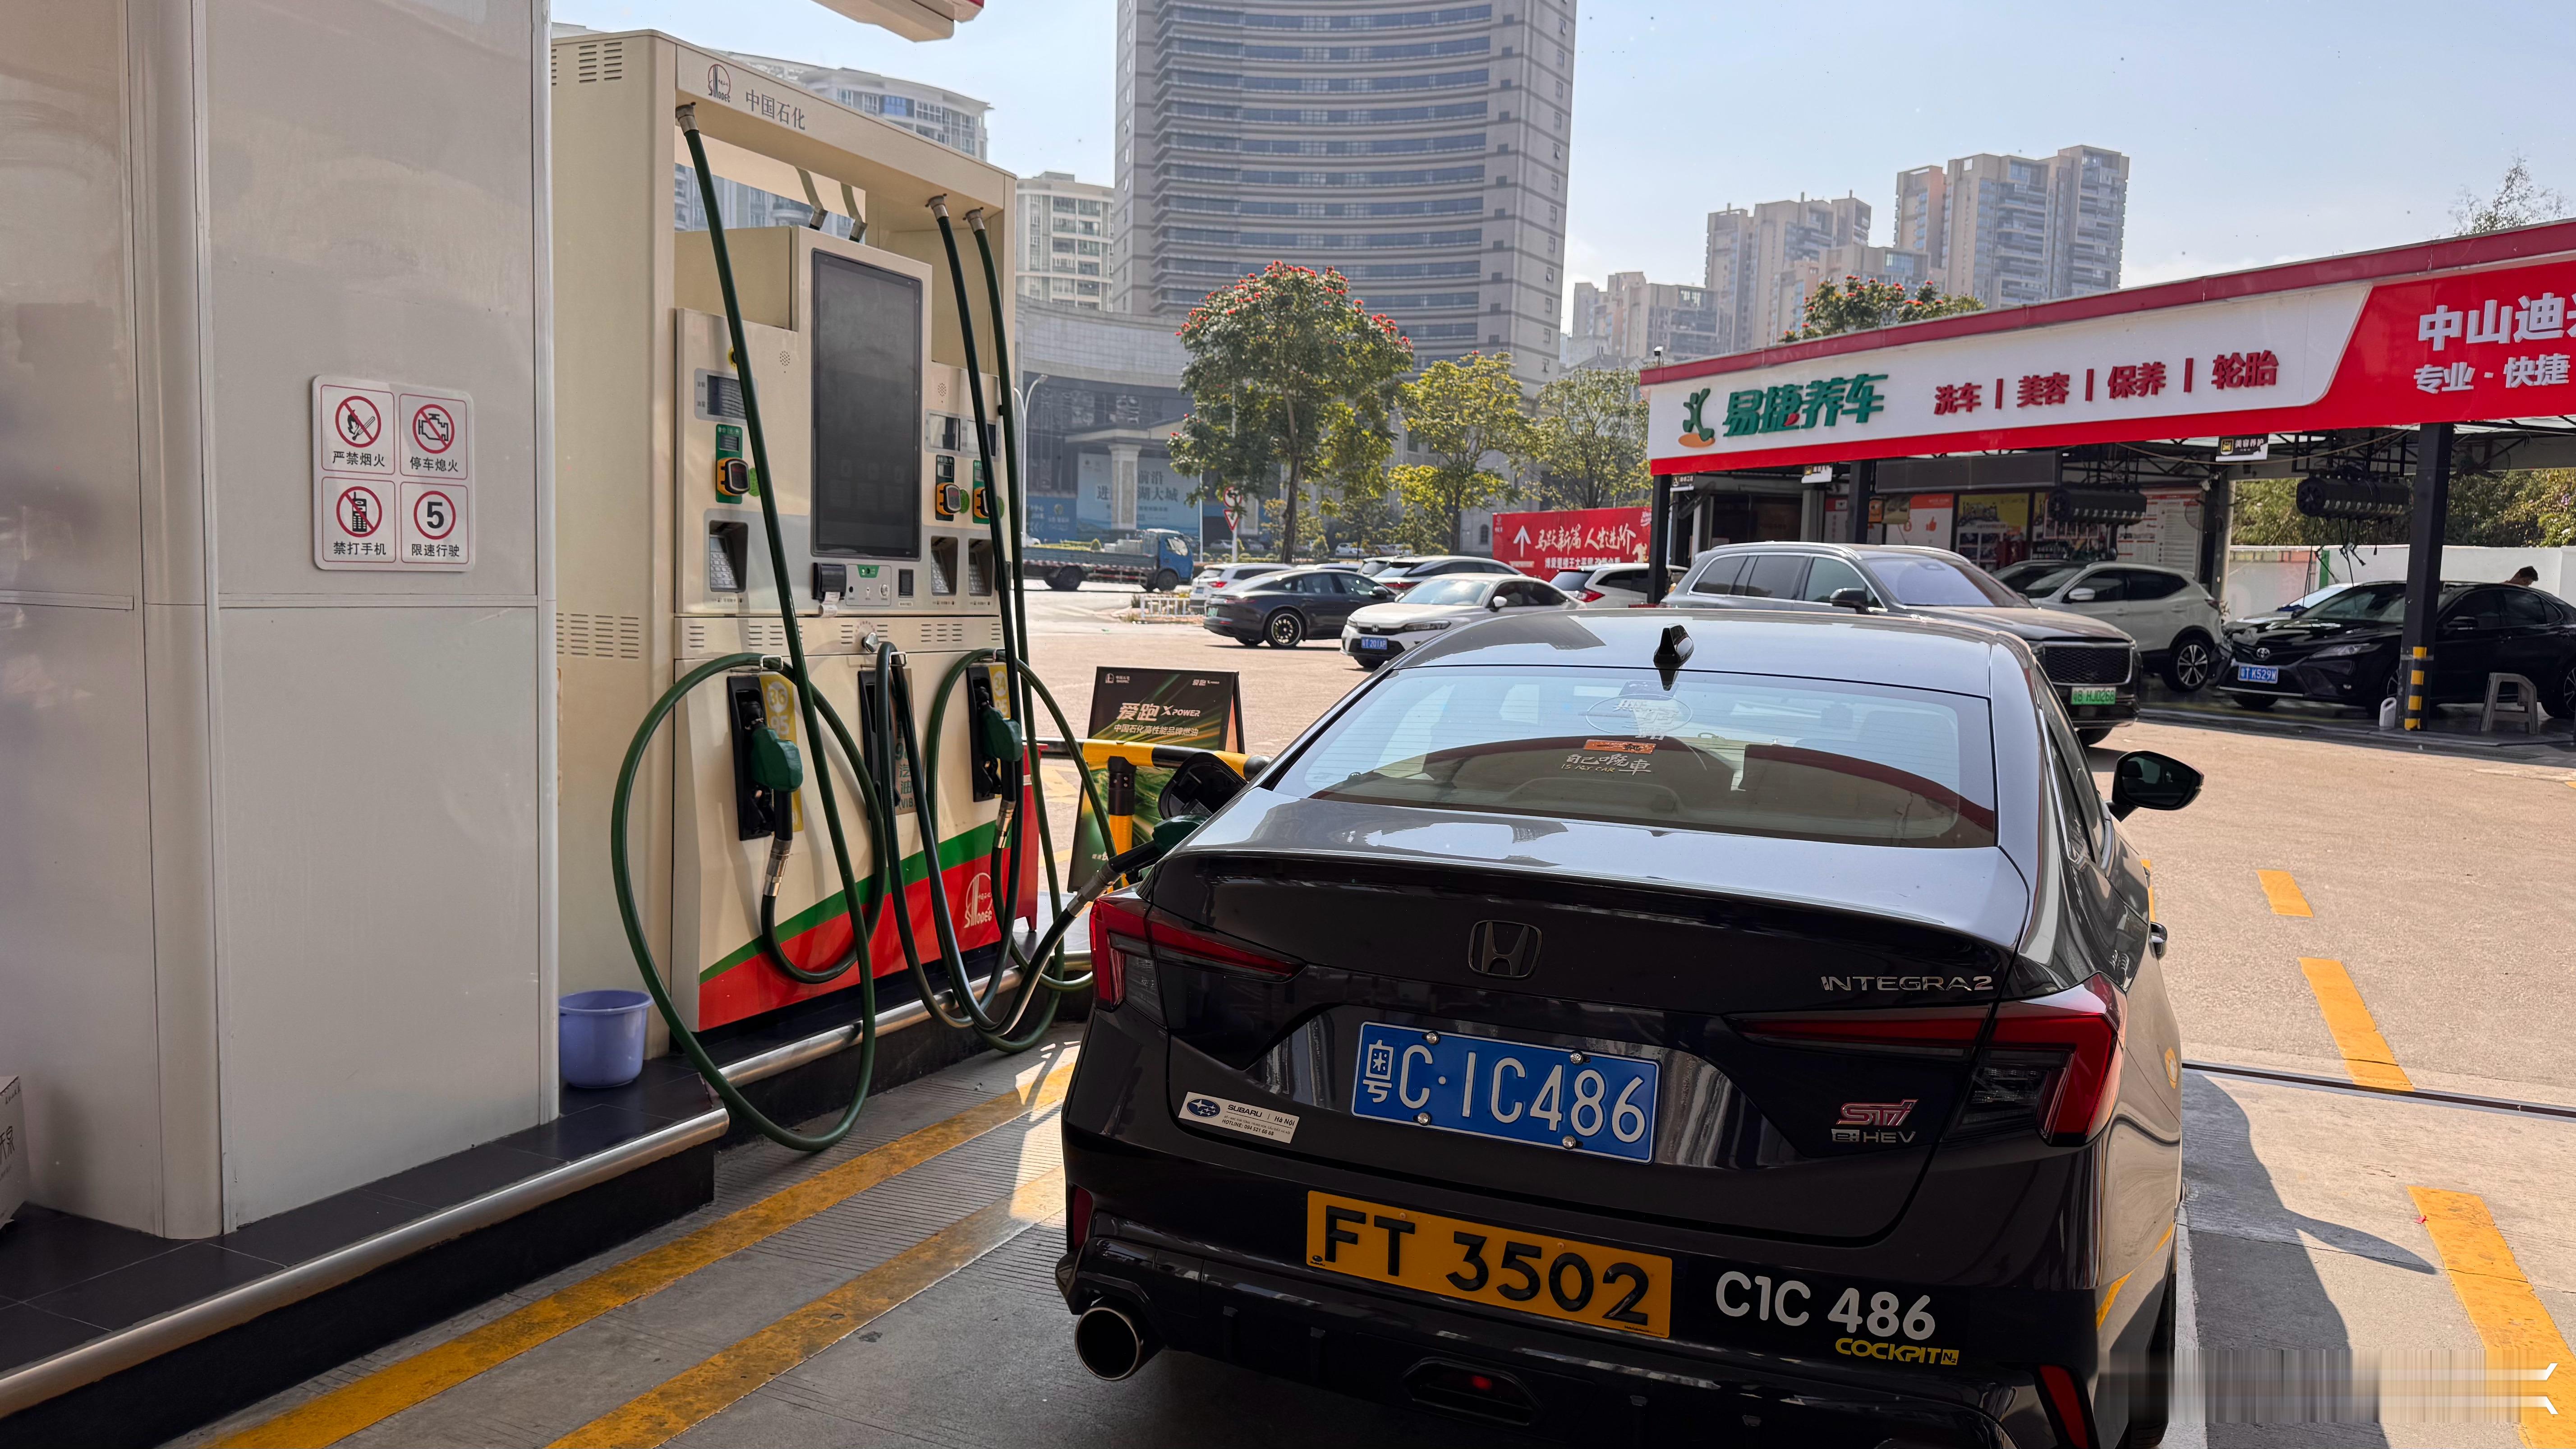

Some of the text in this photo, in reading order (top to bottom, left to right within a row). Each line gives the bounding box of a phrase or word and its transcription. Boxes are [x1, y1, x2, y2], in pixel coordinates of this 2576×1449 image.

[746, 88, 805, 131] 中国石化
[2418, 291, 2576, 351] 中山迪
[1722, 373, 1889, 437] 易捷养车
[332, 451, 386, 467] 严禁烟火
[409, 456, 459, 472] 停车熄火
[426, 501, 445, 529] 5
[333, 541, 386, 556] 禁打手机
[411, 544, 460, 557] 限速行驶
[995, 676, 1007, 691] 34
[770, 689, 787, 704] 36
[1116, 702, 1160, 722] 爱跑
[770, 714, 789, 736] 95
[1114, 723, 1199, 736] 中国石化高性能品牌燃油
[1228, 1104, 1262, 1118] SUBARU
[1325, 1205, 1649, 1326] FT 3502
[1716, 1270, 1936, 1340] C1C 486
